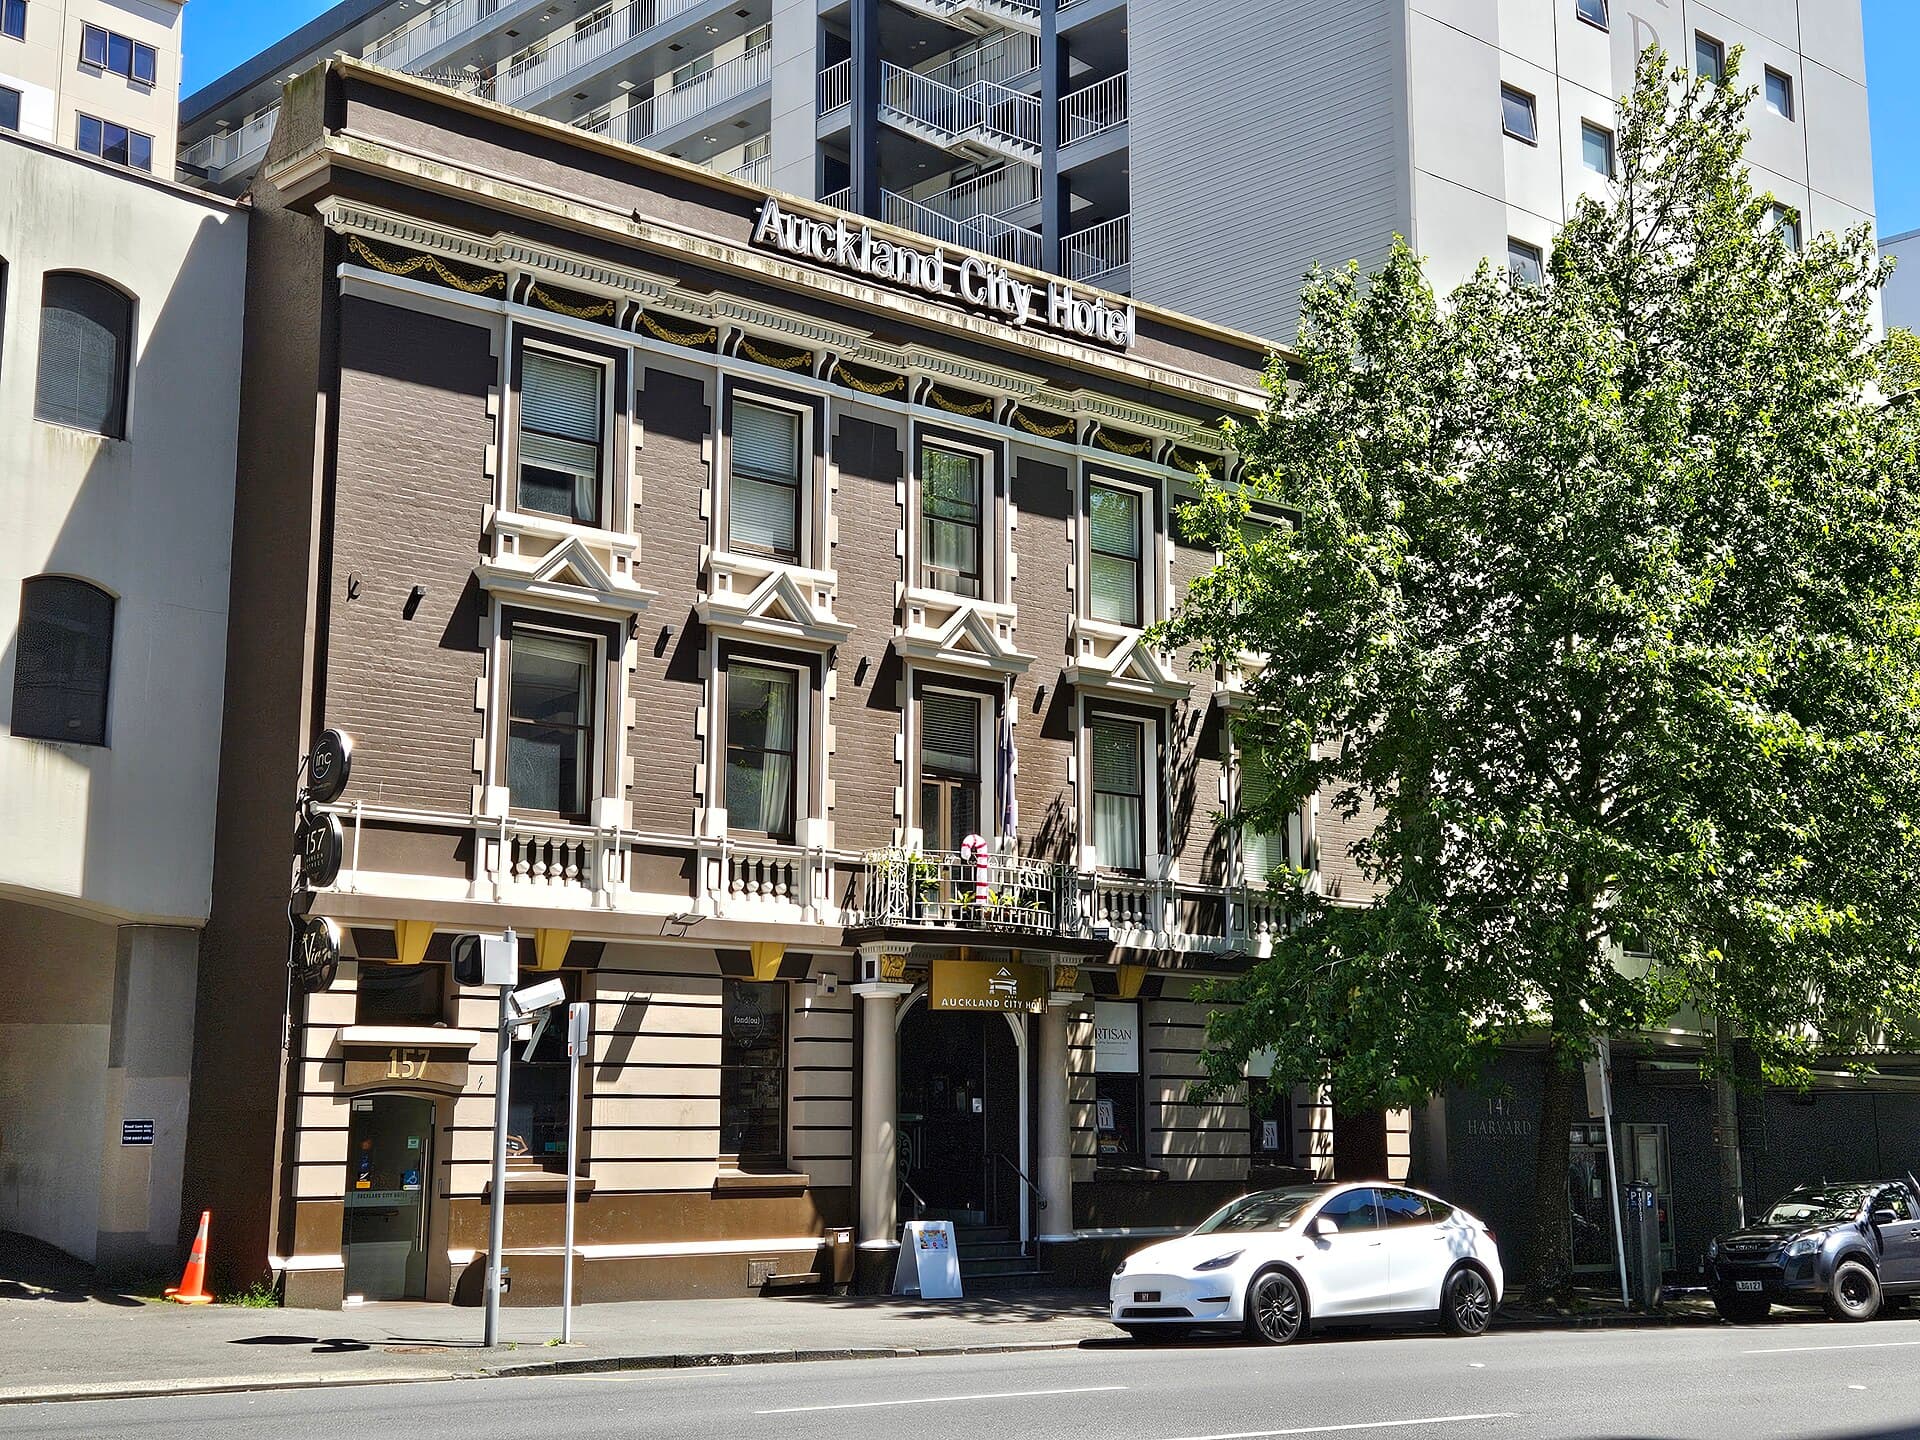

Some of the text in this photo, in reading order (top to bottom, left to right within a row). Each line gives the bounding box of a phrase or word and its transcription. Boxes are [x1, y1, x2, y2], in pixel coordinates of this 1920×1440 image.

[754, 196, 1136, 349] Auckland City Hotel
[306, 828, 327, 855] 157
[941, 998, 1000, 1009] AUCKLAND
[1004, 999, 1022, 1010] CITY
[386, 1048, 430, 1079] 157
[1468, 1119, 1532, 1135] HARVARD
[1630, 1191, 1637, 1201] P
[1646, 1191, 1652, 1201] P
